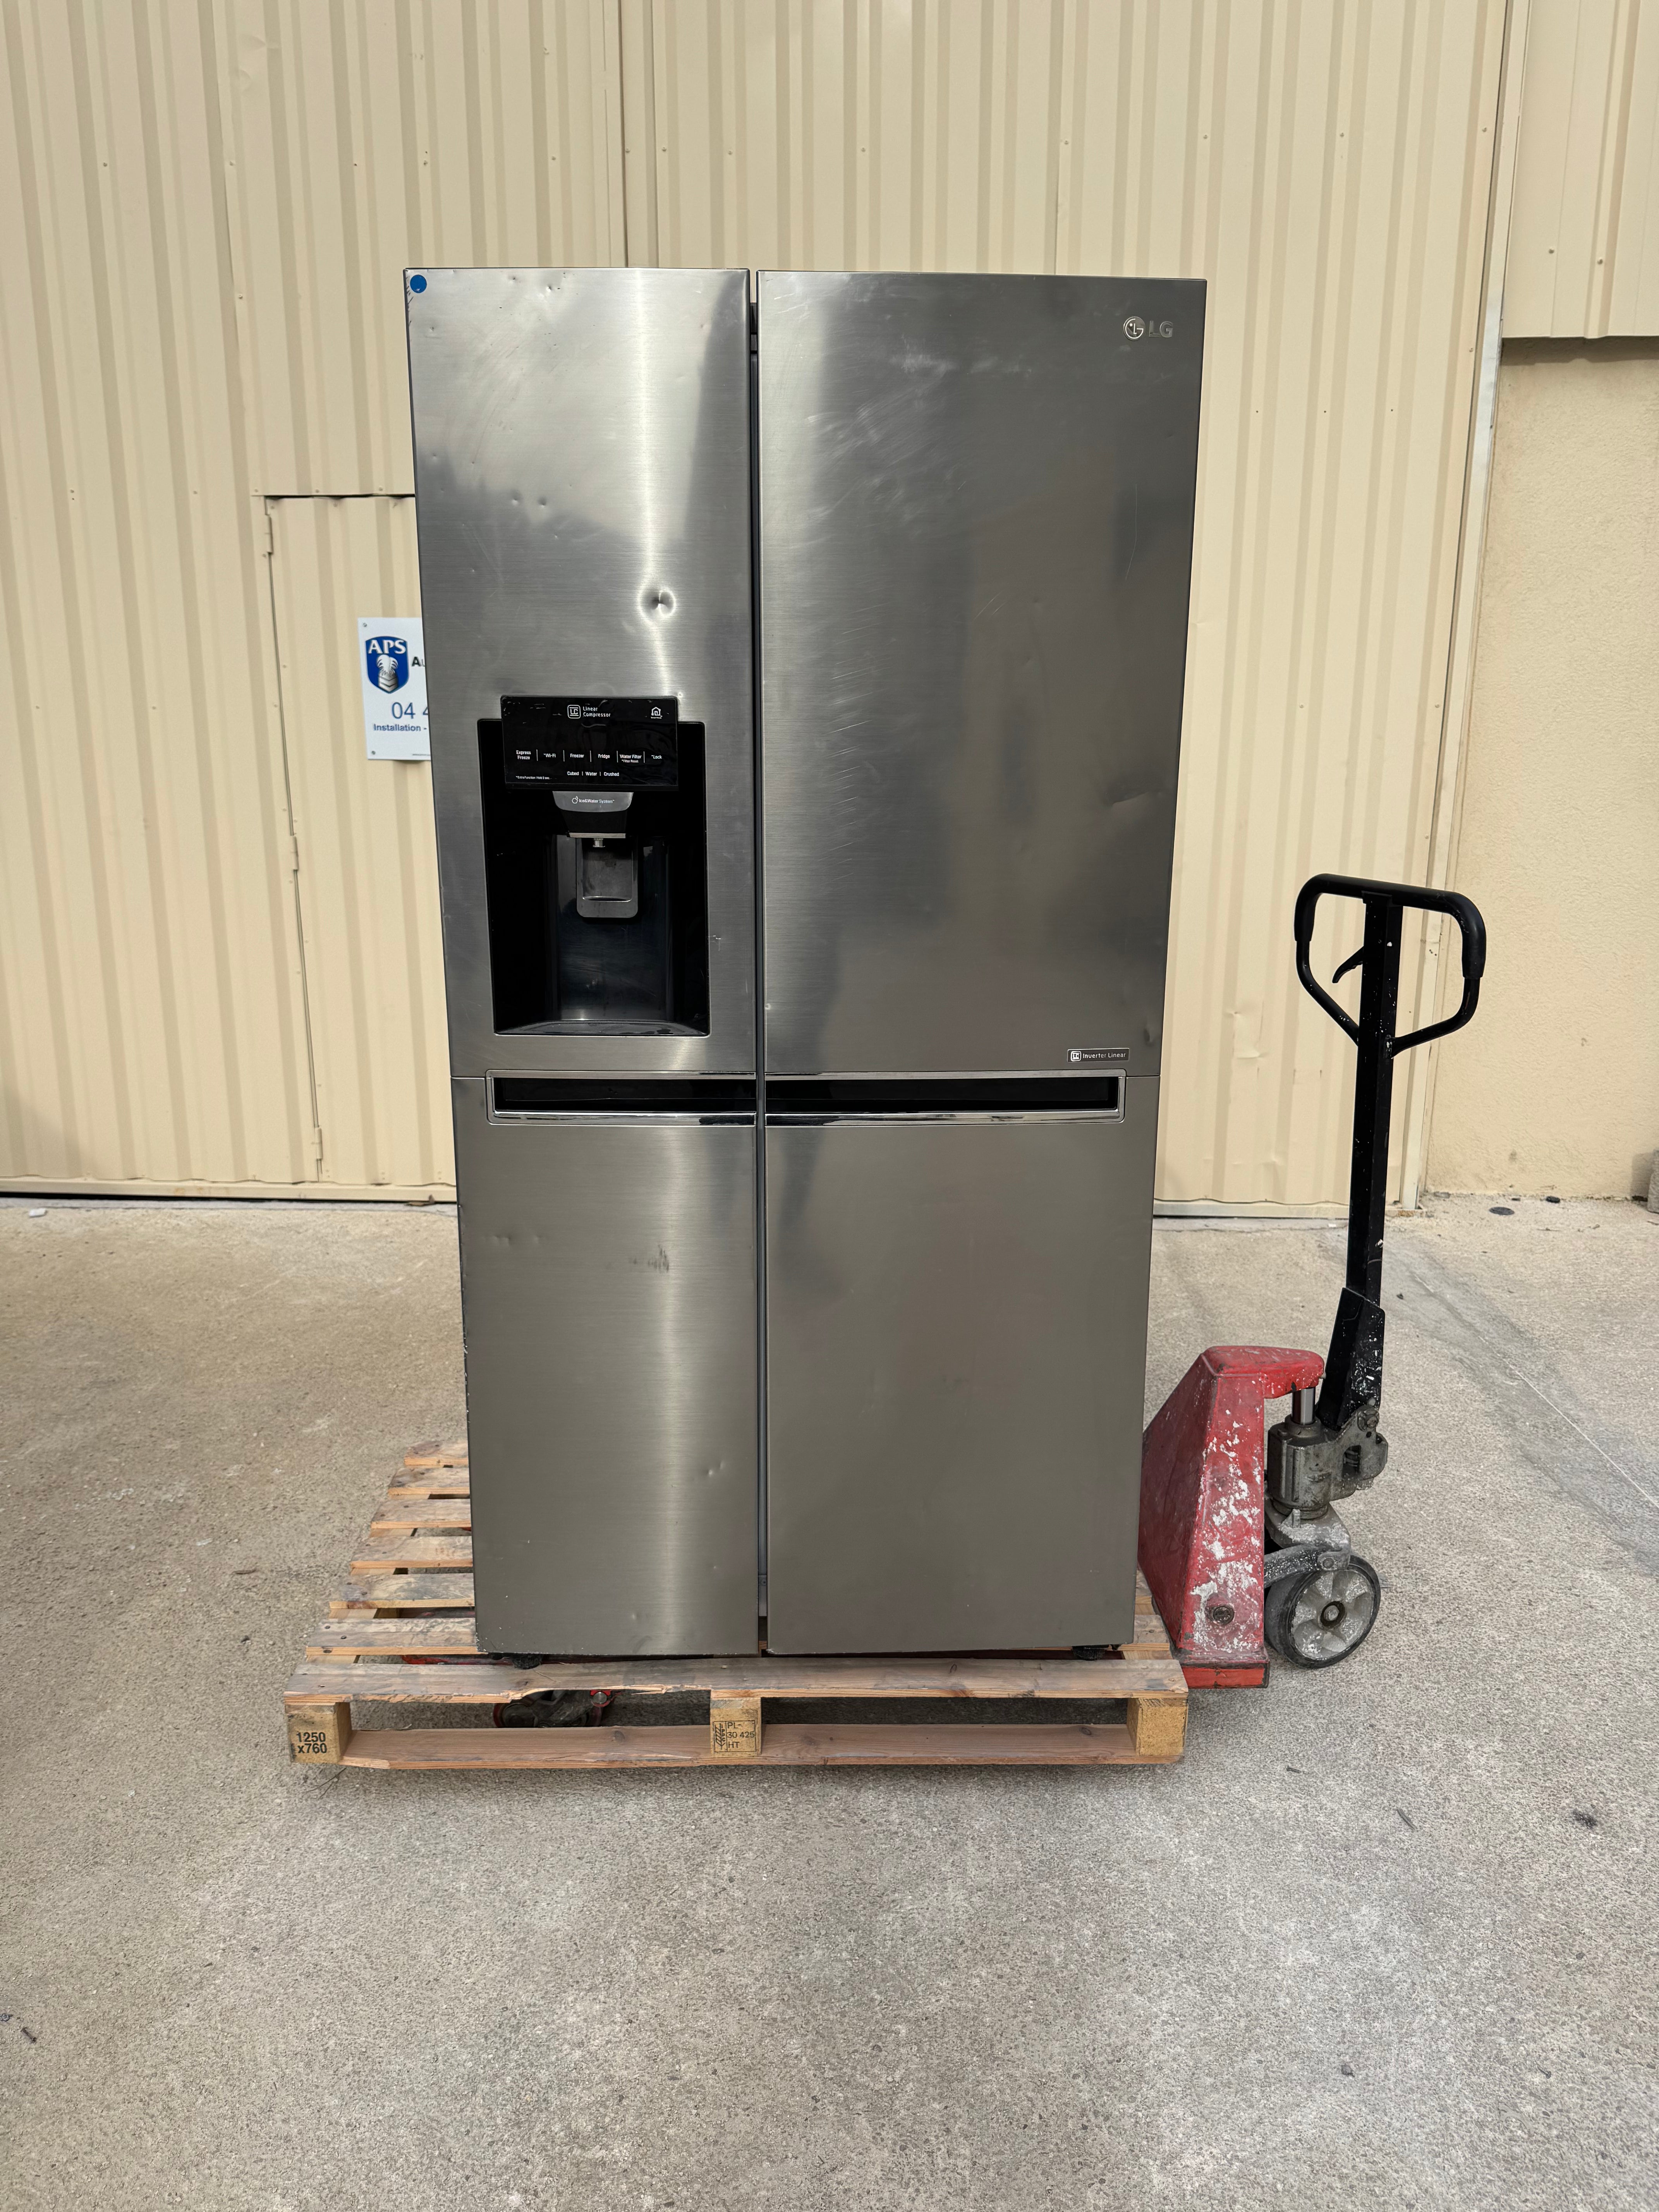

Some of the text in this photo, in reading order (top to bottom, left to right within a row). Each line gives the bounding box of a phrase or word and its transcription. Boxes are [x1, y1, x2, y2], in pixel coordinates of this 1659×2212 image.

[1149, 321, 1173, 338] LG
[368, 640, 406, 654] APS
[392, 702, 416, 719] 04
[296, 1732, 326, 1742] 1250
[297, 1743, 327, 1754] x760
